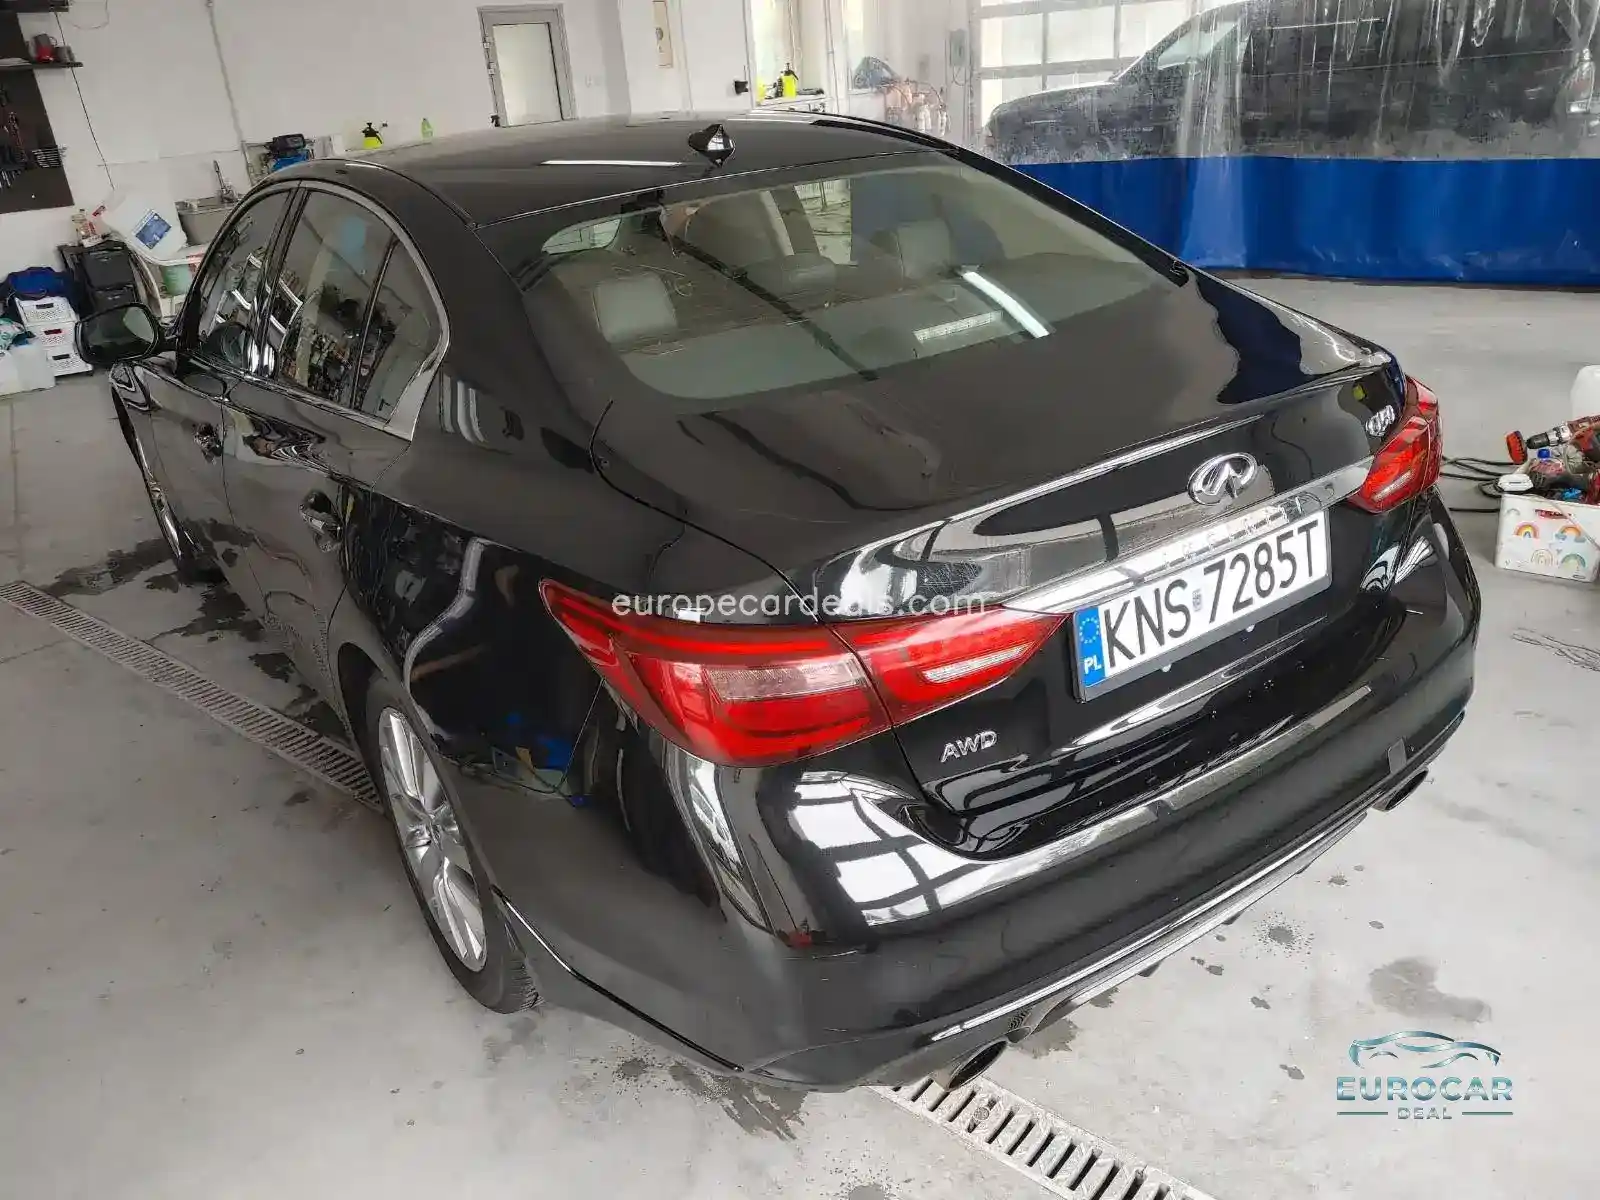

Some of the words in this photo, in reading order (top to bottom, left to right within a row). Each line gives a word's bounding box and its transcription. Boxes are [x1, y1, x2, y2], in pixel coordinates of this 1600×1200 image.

[1104, 578, 1191, 668] KNS
[1203, 519, 1319, 603] 7285T
[1084, 656, 1102, 675] PL
[941, 731, 998, 763] AWD
